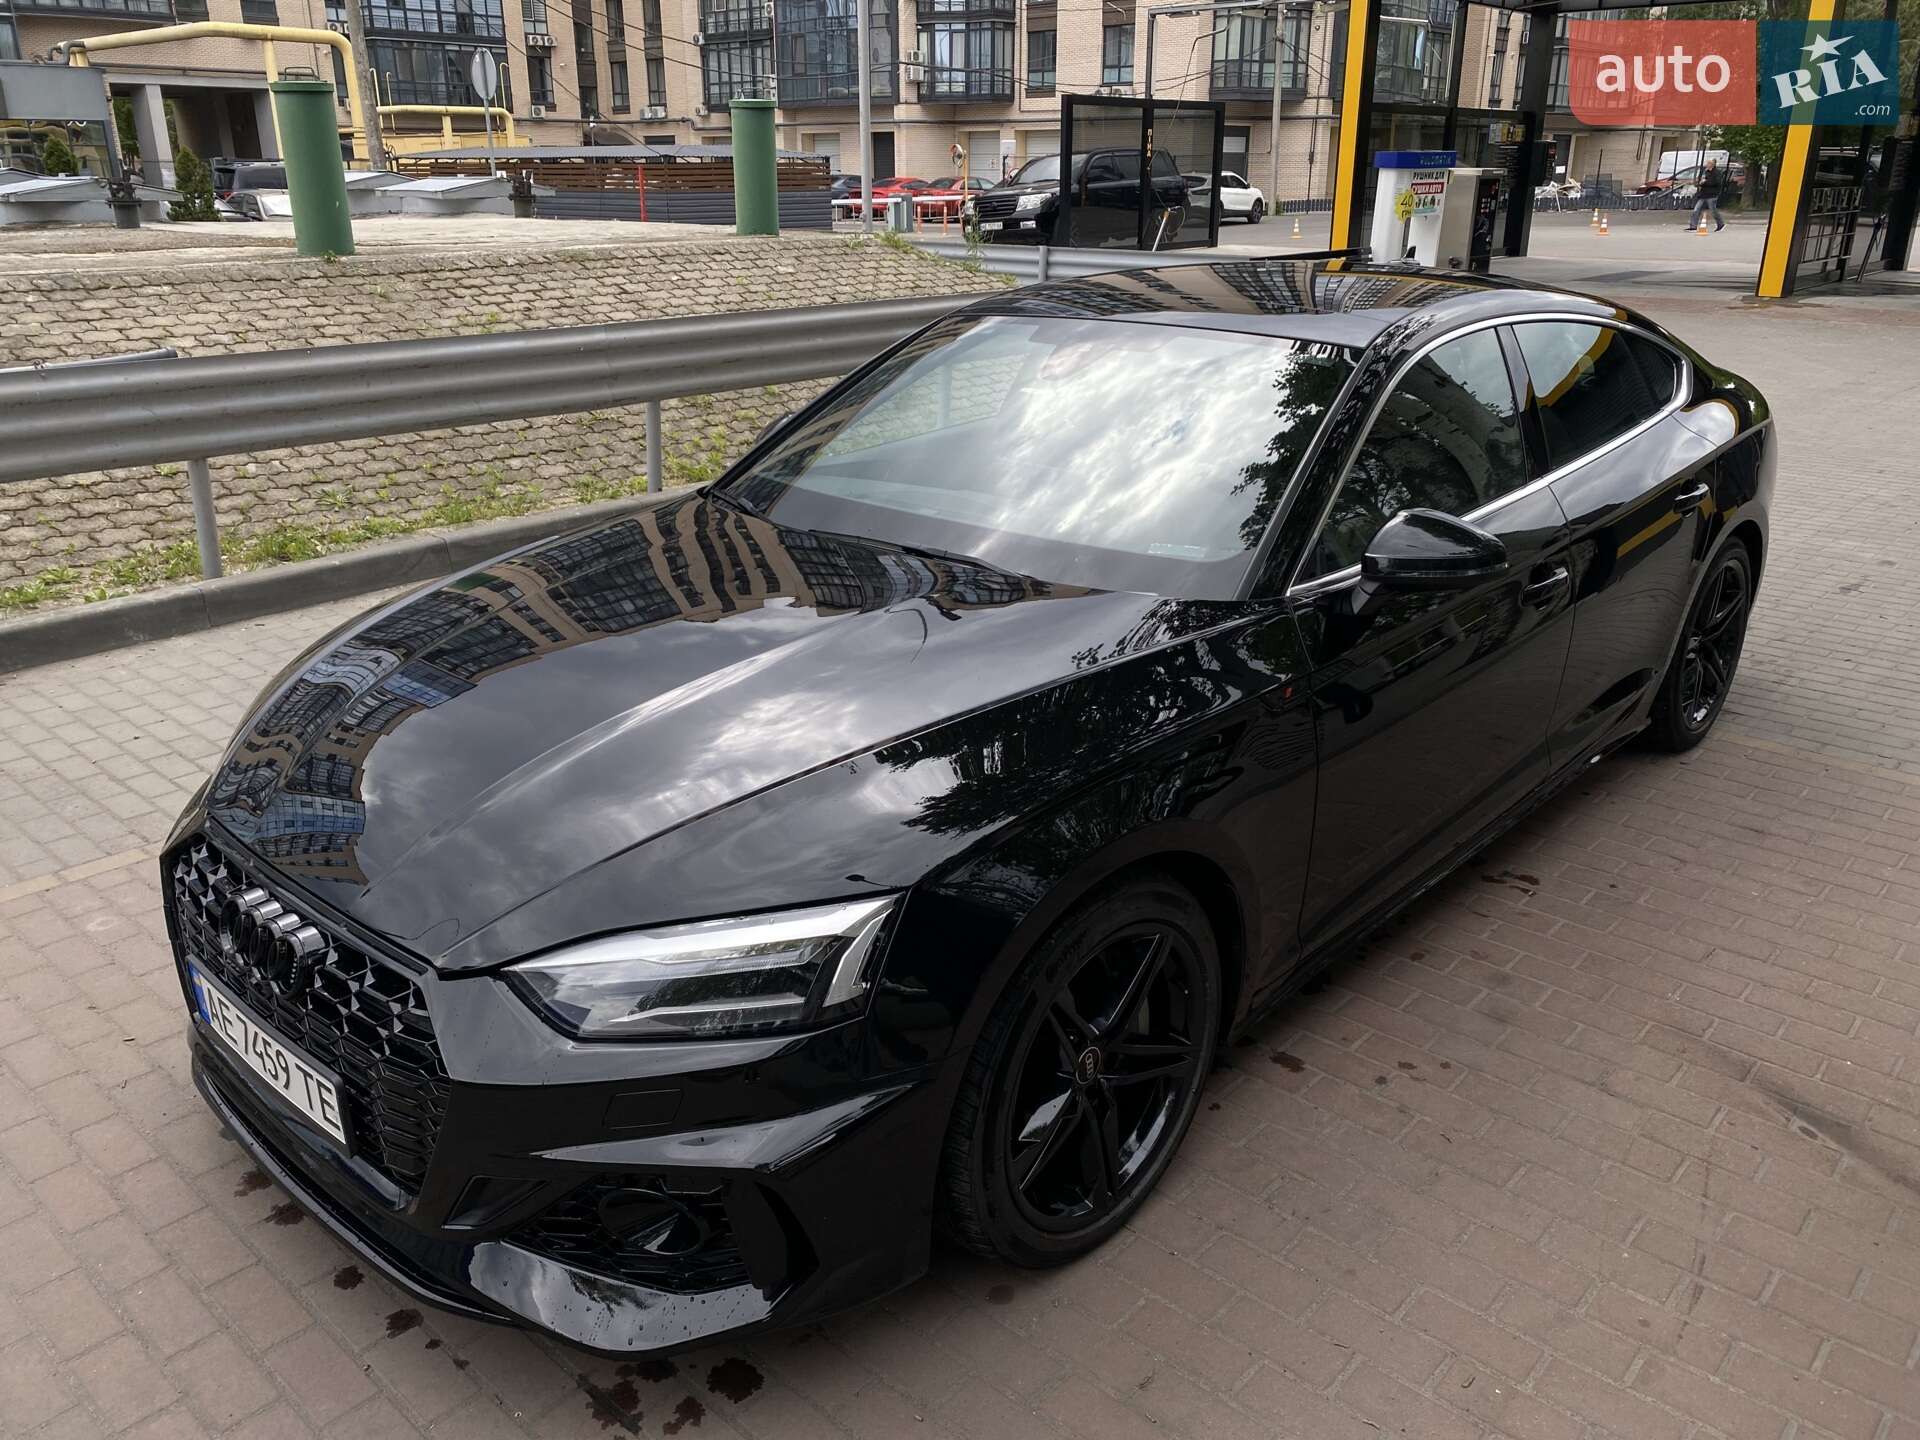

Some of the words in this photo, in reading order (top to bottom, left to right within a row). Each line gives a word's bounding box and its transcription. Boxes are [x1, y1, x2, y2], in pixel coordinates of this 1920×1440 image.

[1400, 194, 1413, 208] 40
[207, 986, 238, 1046] AE
[236, 1013, 290, 1090] 7459
[295, 1062, 341, 1132] TE
